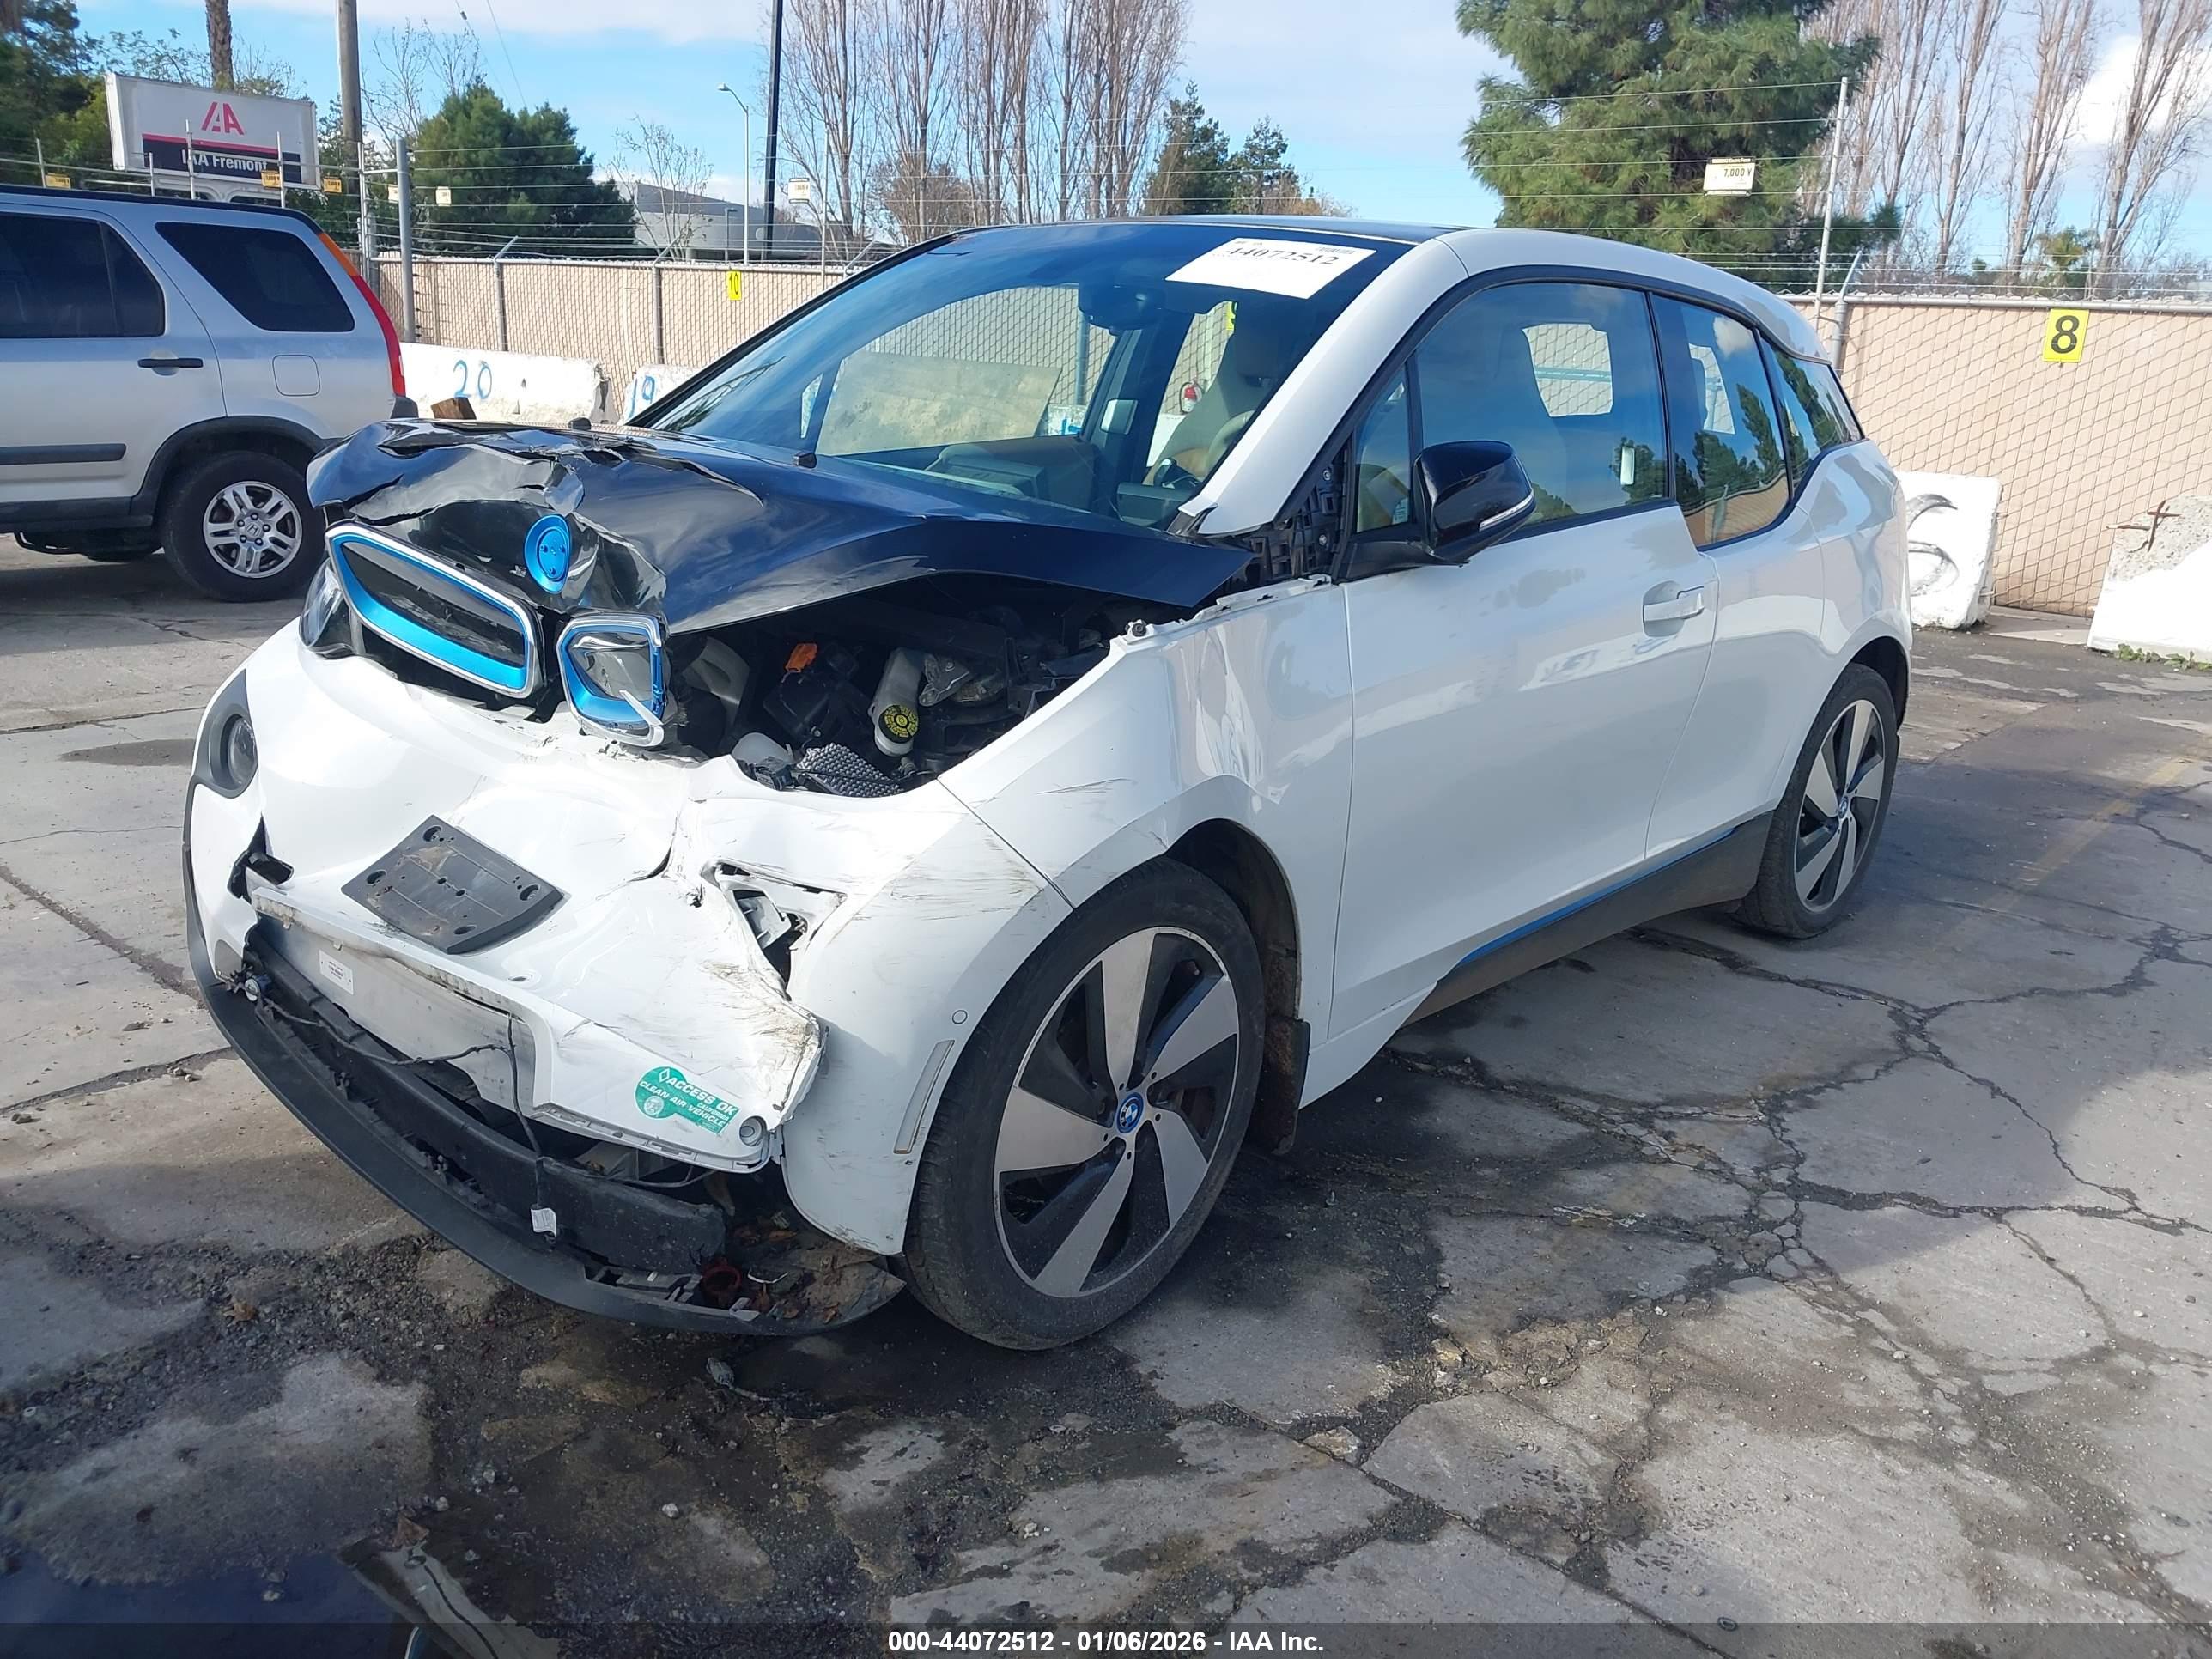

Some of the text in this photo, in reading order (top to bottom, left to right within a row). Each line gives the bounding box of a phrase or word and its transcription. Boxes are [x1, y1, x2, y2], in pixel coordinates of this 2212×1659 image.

[212, 155, 267, 172] Fremont
[1723, 167, 1745, 178] 7,000
[1226, 246, 1340, 265] 44072512
[729, 272, 739, 295] 10
[2051, 315, 2080, 354] 8
[453, 359, 493, 400] 20
[628, 375, 655, 419] 19
[639, 1080, 670, 1099] CLEAN
[670, 1096, 688, 1108] AIR
[688, 1104, 726, 1127] VEHICLE
[666, 1077, 738, 1115] ACCESS OK
